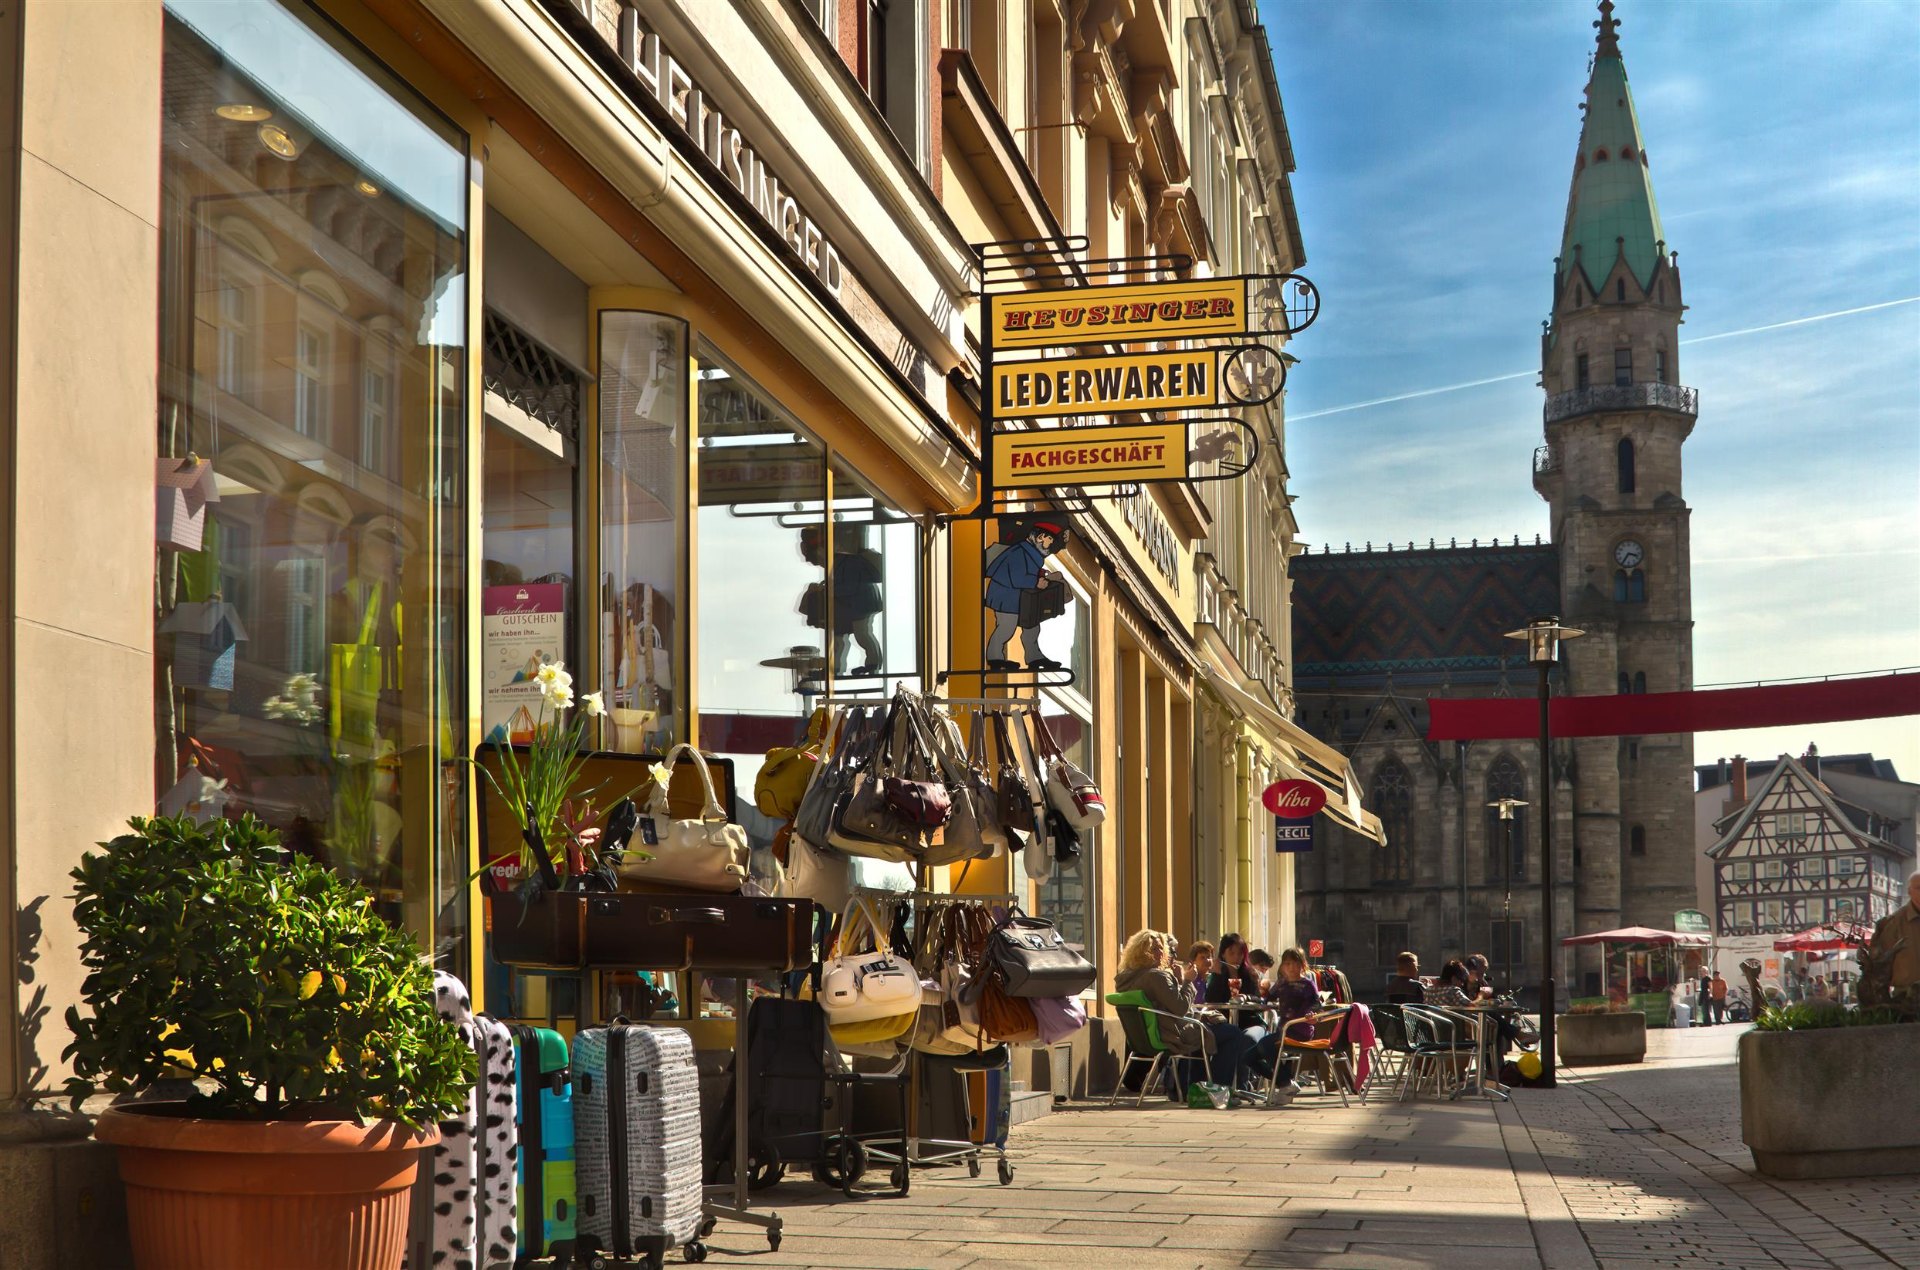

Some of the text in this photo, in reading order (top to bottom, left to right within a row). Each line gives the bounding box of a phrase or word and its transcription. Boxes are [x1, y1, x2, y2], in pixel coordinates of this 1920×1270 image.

[1003, 297, 1235, 331] HEUSINGER
[1000, 362, 1207, 409] LEDERWAREN
[1010, 441, 1165, 469] FACHGESCHÄFT
[502, 614, 557, 625] GUTSCHEIN
[501, 629, 522, 637] haben
[1277, 786, 1311, 807] Viba
[1277, 828, 1310, 838] CECIL
